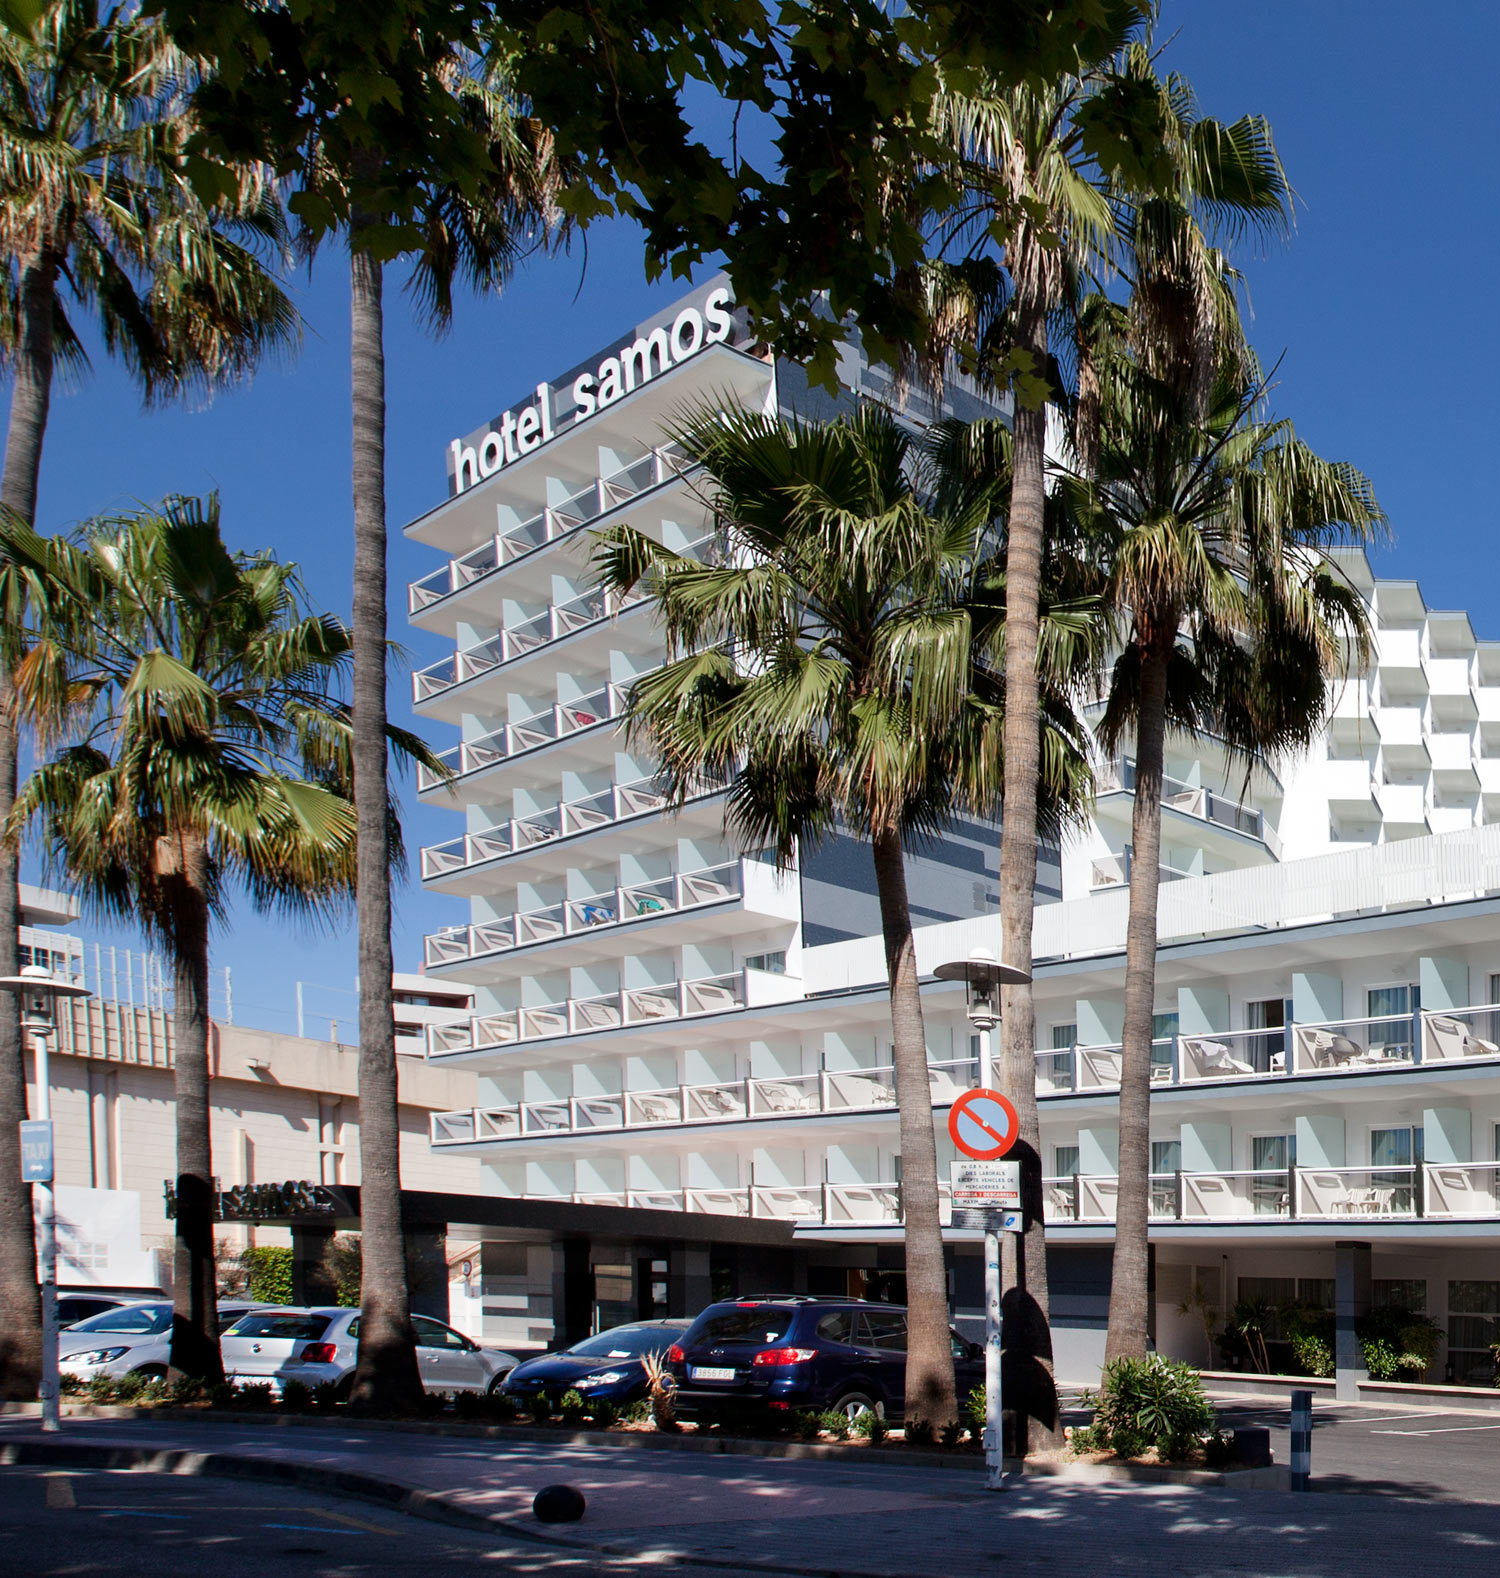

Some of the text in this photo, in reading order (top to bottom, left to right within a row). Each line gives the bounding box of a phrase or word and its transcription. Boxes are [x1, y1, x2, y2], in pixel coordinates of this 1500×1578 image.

[451, 287, 732, 495] hotel samos
[23, 1143, 49, 1160] TAXI
